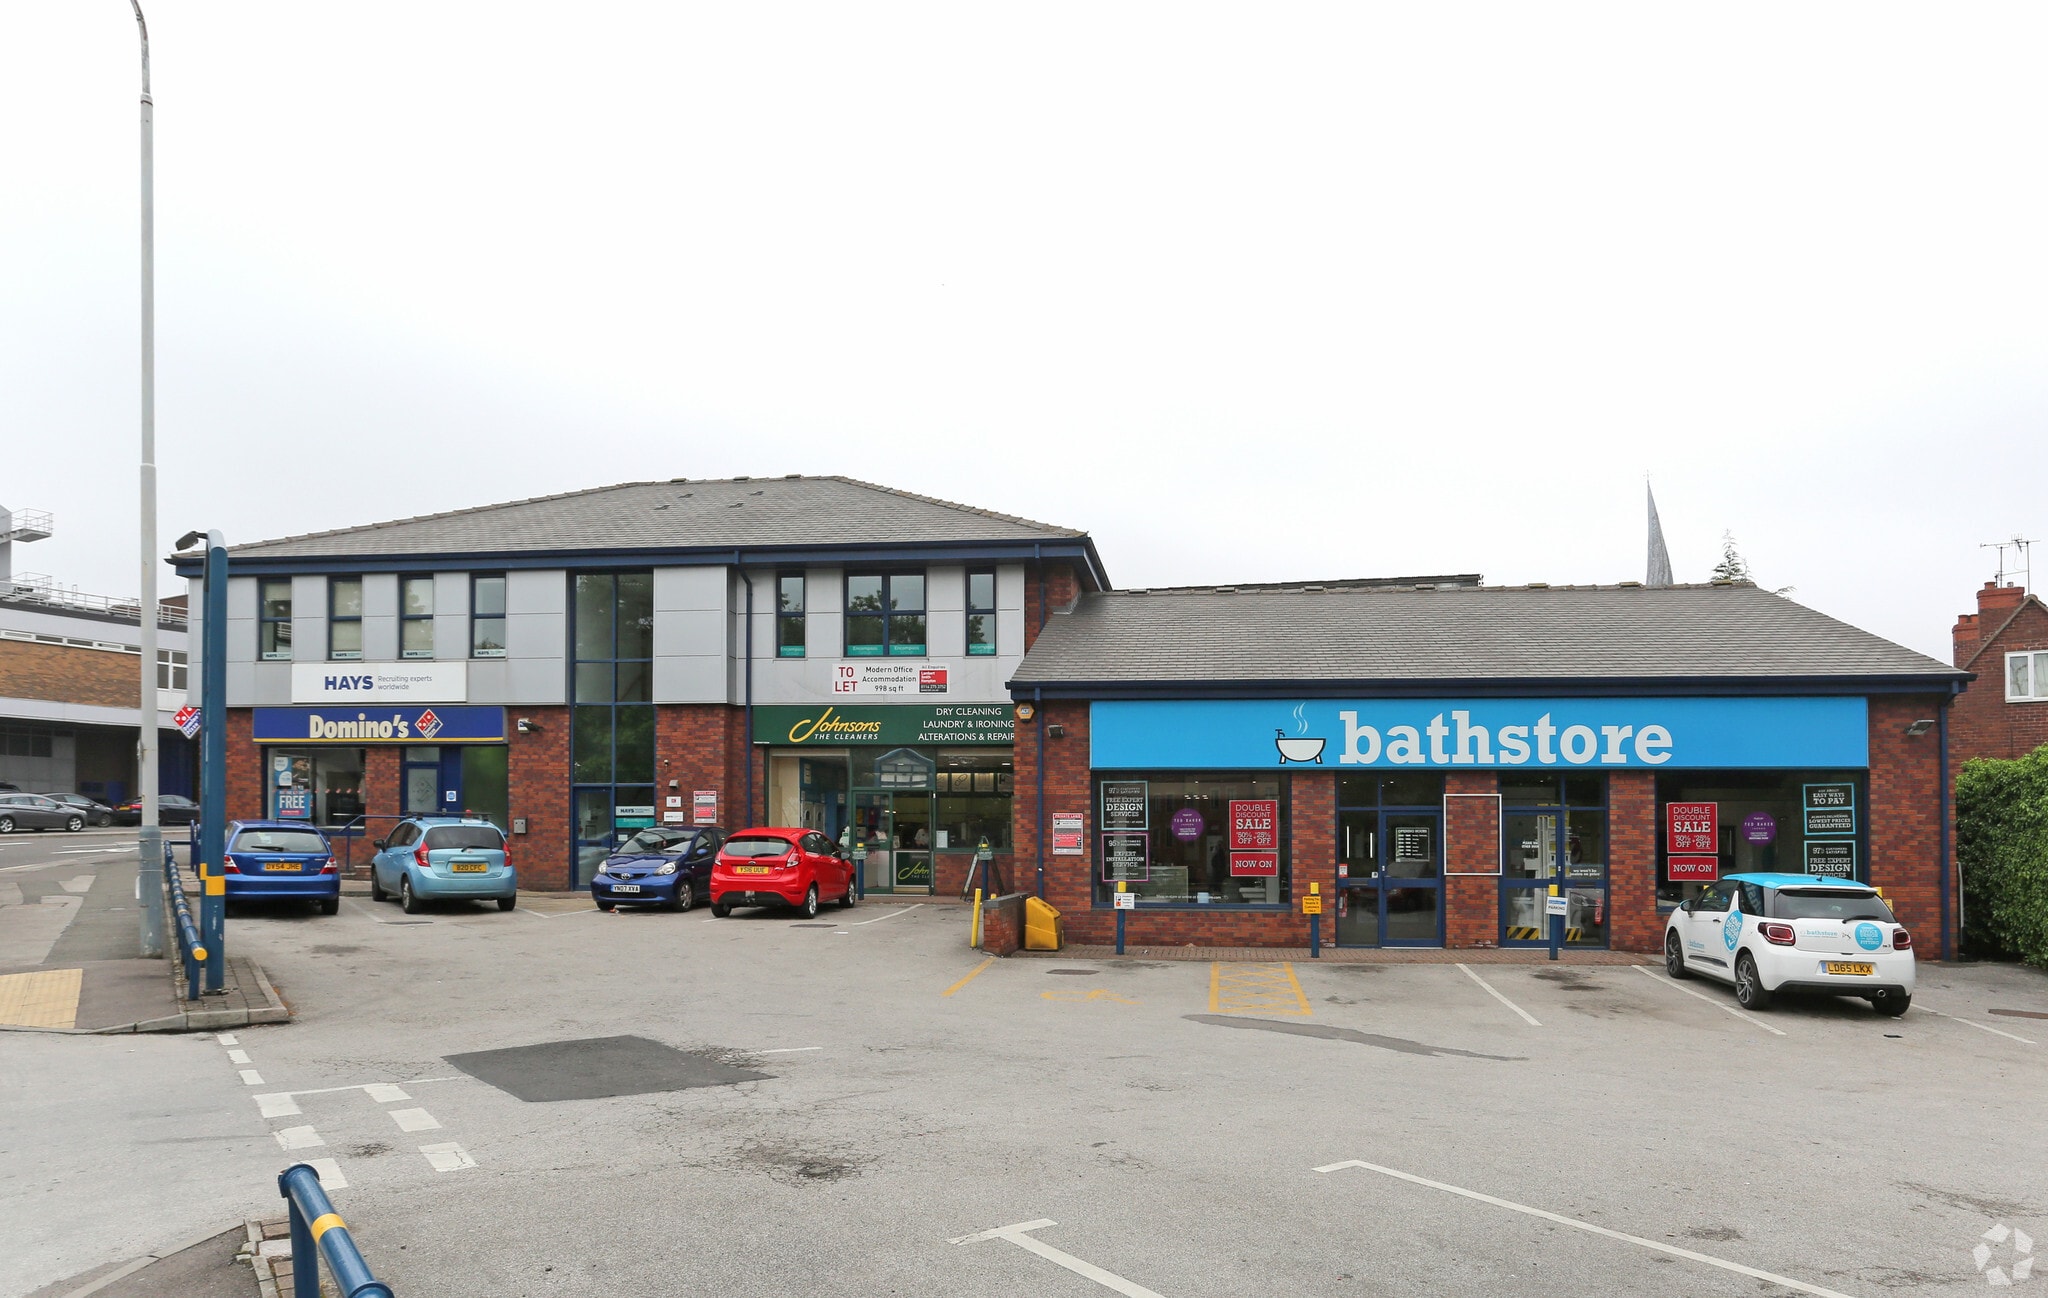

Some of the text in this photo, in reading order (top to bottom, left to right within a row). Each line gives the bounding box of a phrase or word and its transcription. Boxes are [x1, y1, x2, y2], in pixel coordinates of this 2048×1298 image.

[838, 666, 854, 678] TO
[324, 676, 374, 690] HAYS
[835, 681, 858, 692] LET
[936, 708, 1002, 716] DRY CLEANING
[310, 712, 410, 738] Domino's
[788, 706, 881, 742] Johnsons
[923, 720, 1014, 728] LAUNDRY & IRONING
[918, 732, 976, 741] ALTERATIONS
[978, 732, 986, 741] &
[1339, 710, 1673, 764] bathstore
[279, 795, 305, 809] FREE
[1236, 818, 1271, 830] SALE
[1674, 821, 1711, 832] SALE
[1810, 864, 1851, 872] DESIGN
[1828, 964, 1872, 973] LD65 LKX
